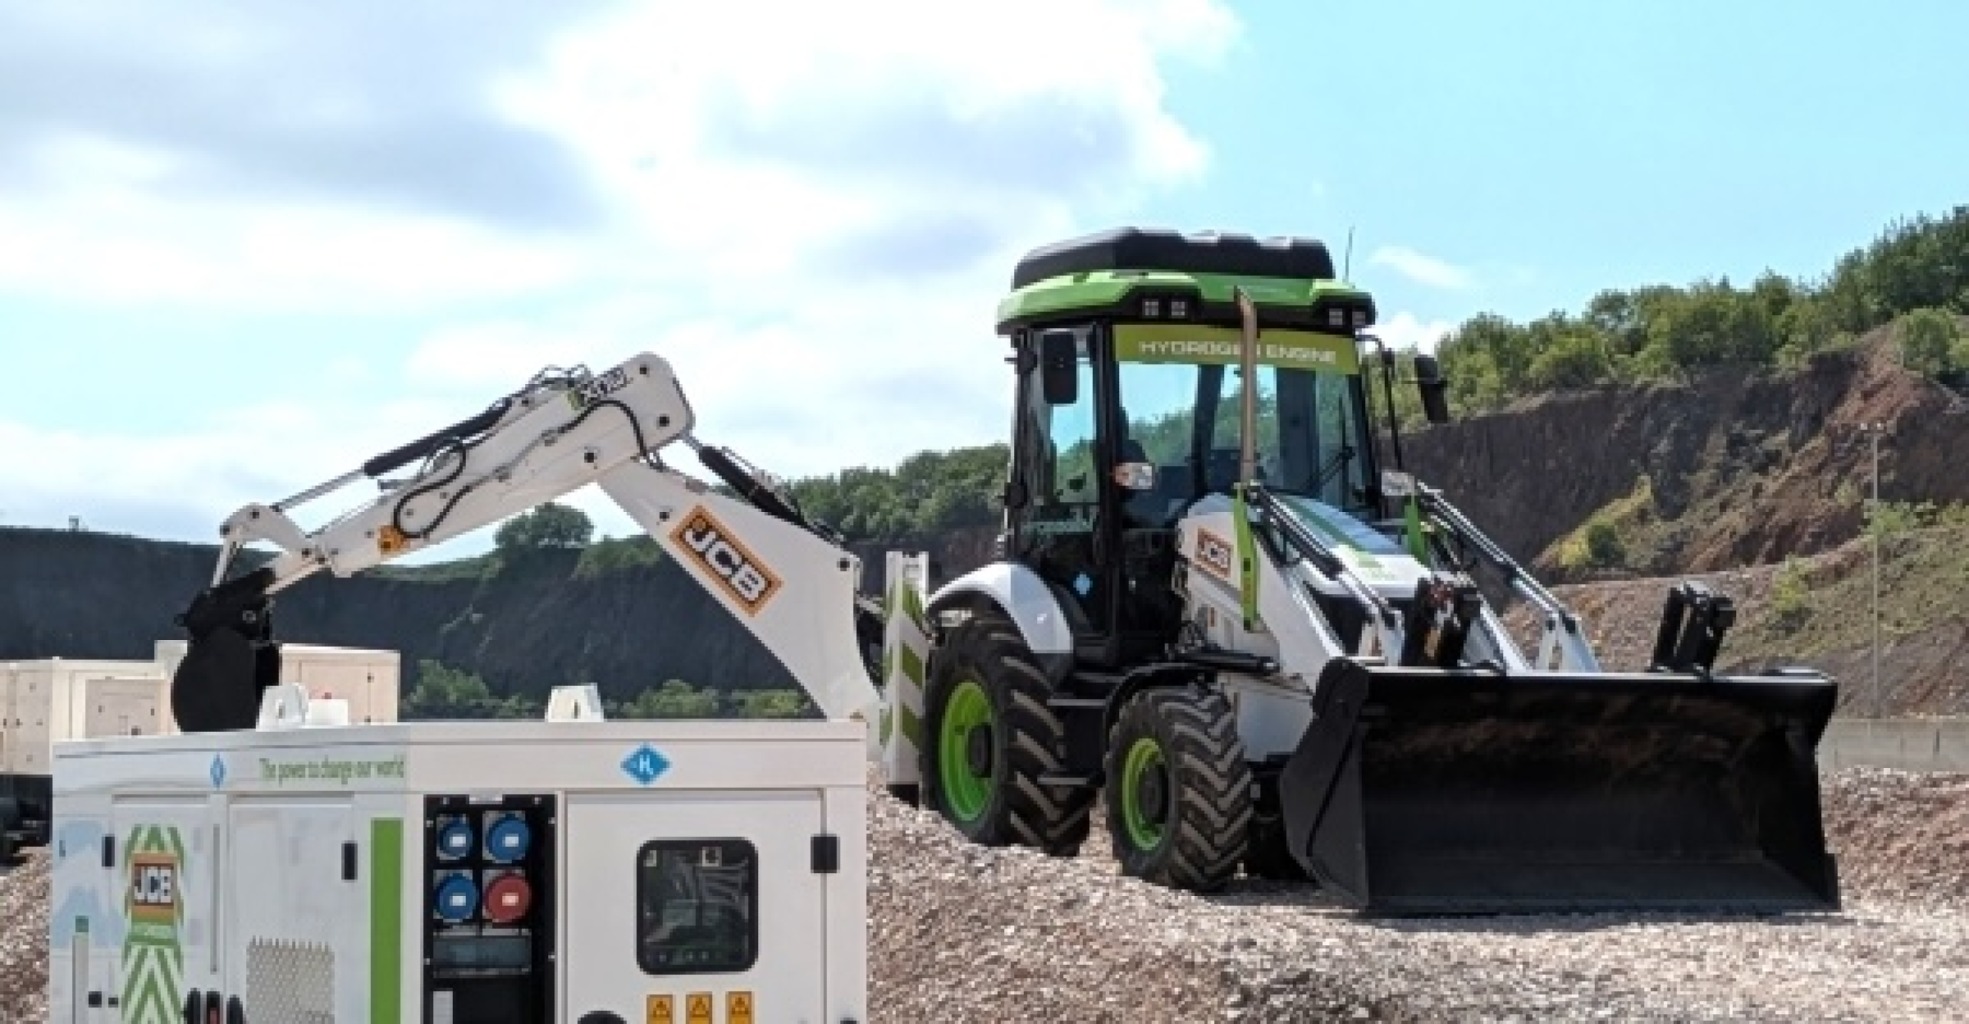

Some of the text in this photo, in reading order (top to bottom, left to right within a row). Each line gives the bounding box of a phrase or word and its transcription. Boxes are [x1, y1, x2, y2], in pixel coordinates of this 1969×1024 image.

[1265, 344, 1338, 364] ENGINE
[684, 529, 767, 601] JCB
[1200, 540, 1228, 569] JCB
[258, 757, 276, 779] The
[133, 866, 174, 903] JCB
